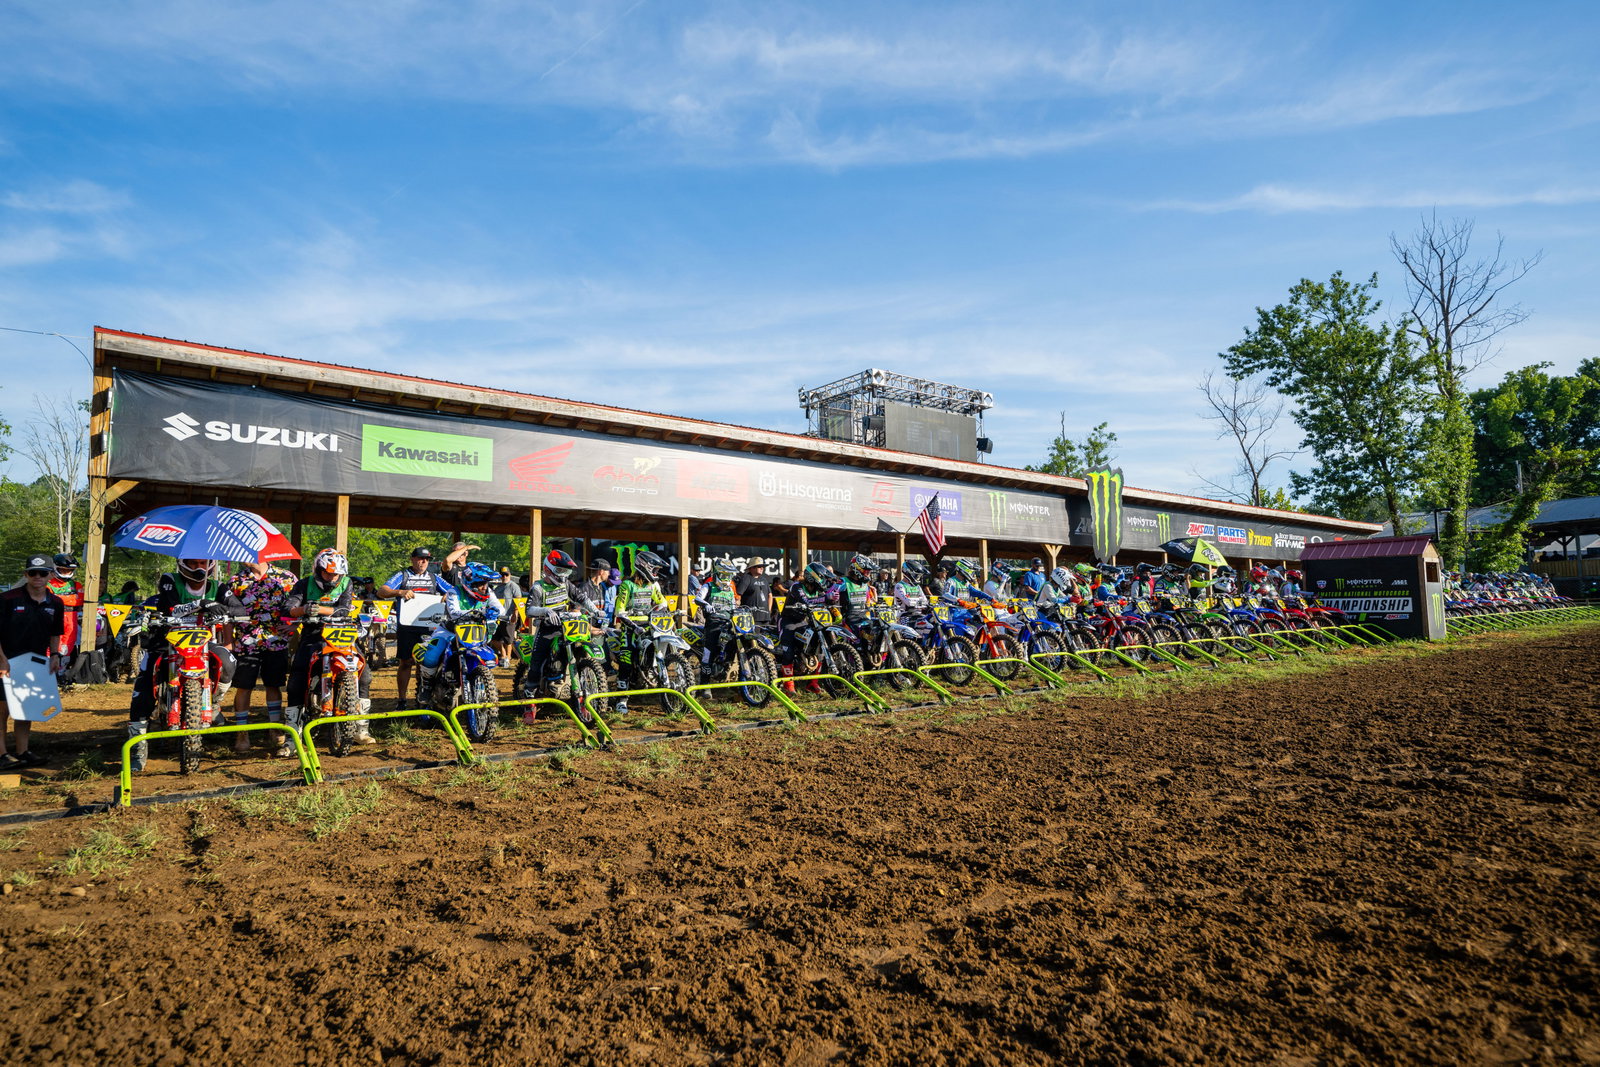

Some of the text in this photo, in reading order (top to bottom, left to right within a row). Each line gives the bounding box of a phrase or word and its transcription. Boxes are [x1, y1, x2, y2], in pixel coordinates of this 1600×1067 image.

[204, 421, 339, 452] SUZUKI
[378, 441, 479, 466] Kawasaki
[507, 479, 576, 495] HONDA
[779, 479, 853, 501] Husqvarna
[1009, 502, 1050, 516] MONSTER
[1126, 516, 1158, 528] MONSTER
[141, 527, 180, 542] 100%
[1218, 526, 1246, 538] PARTS
[1254, 535, 1273, 547] THOR
[568, 622, 588, 635] 20
[656, 618, 671, 630] 47
[175, 632, 208, 646] 76
[326, 630, 357, 642] 45
[460, 626, 485, 641] 70
